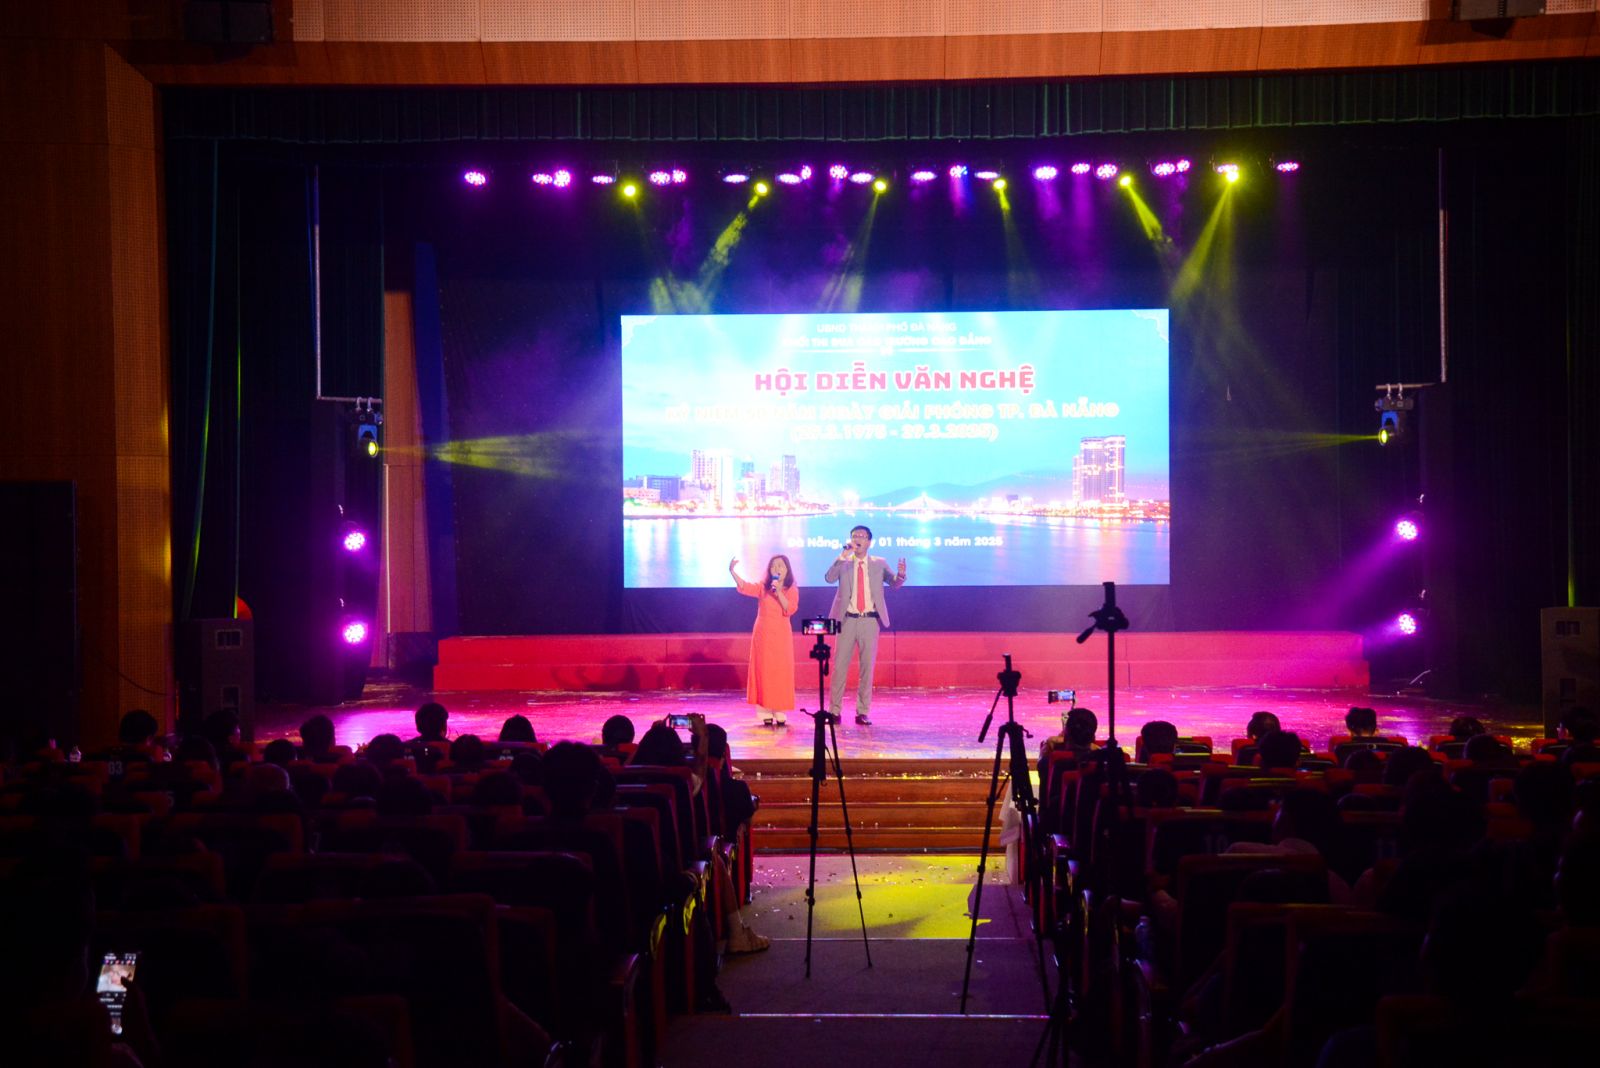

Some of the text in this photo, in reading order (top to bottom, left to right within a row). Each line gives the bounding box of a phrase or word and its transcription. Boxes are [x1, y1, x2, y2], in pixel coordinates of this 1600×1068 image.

[754, 361, 1035, 397] HỘI DIỄN VĂN NGHỆ
[878, 400, 920, 419] GIẢI
[924, 400, 994, 419] PHÓNG
[997, 403, 1025, 418] TP.
[1029, 399, 1058, 418] ĐÀ
[1062, 396, 1120, 418] NẴNG
[878, 537, 892, 547] 01
[896, 536, 931, 549] tháng
[934, 537, 942, 547] 3
[944, 536, 971, 547] năm
[974, 535, 1003, 547] 2025
[108, 760, 123, 776] 03
